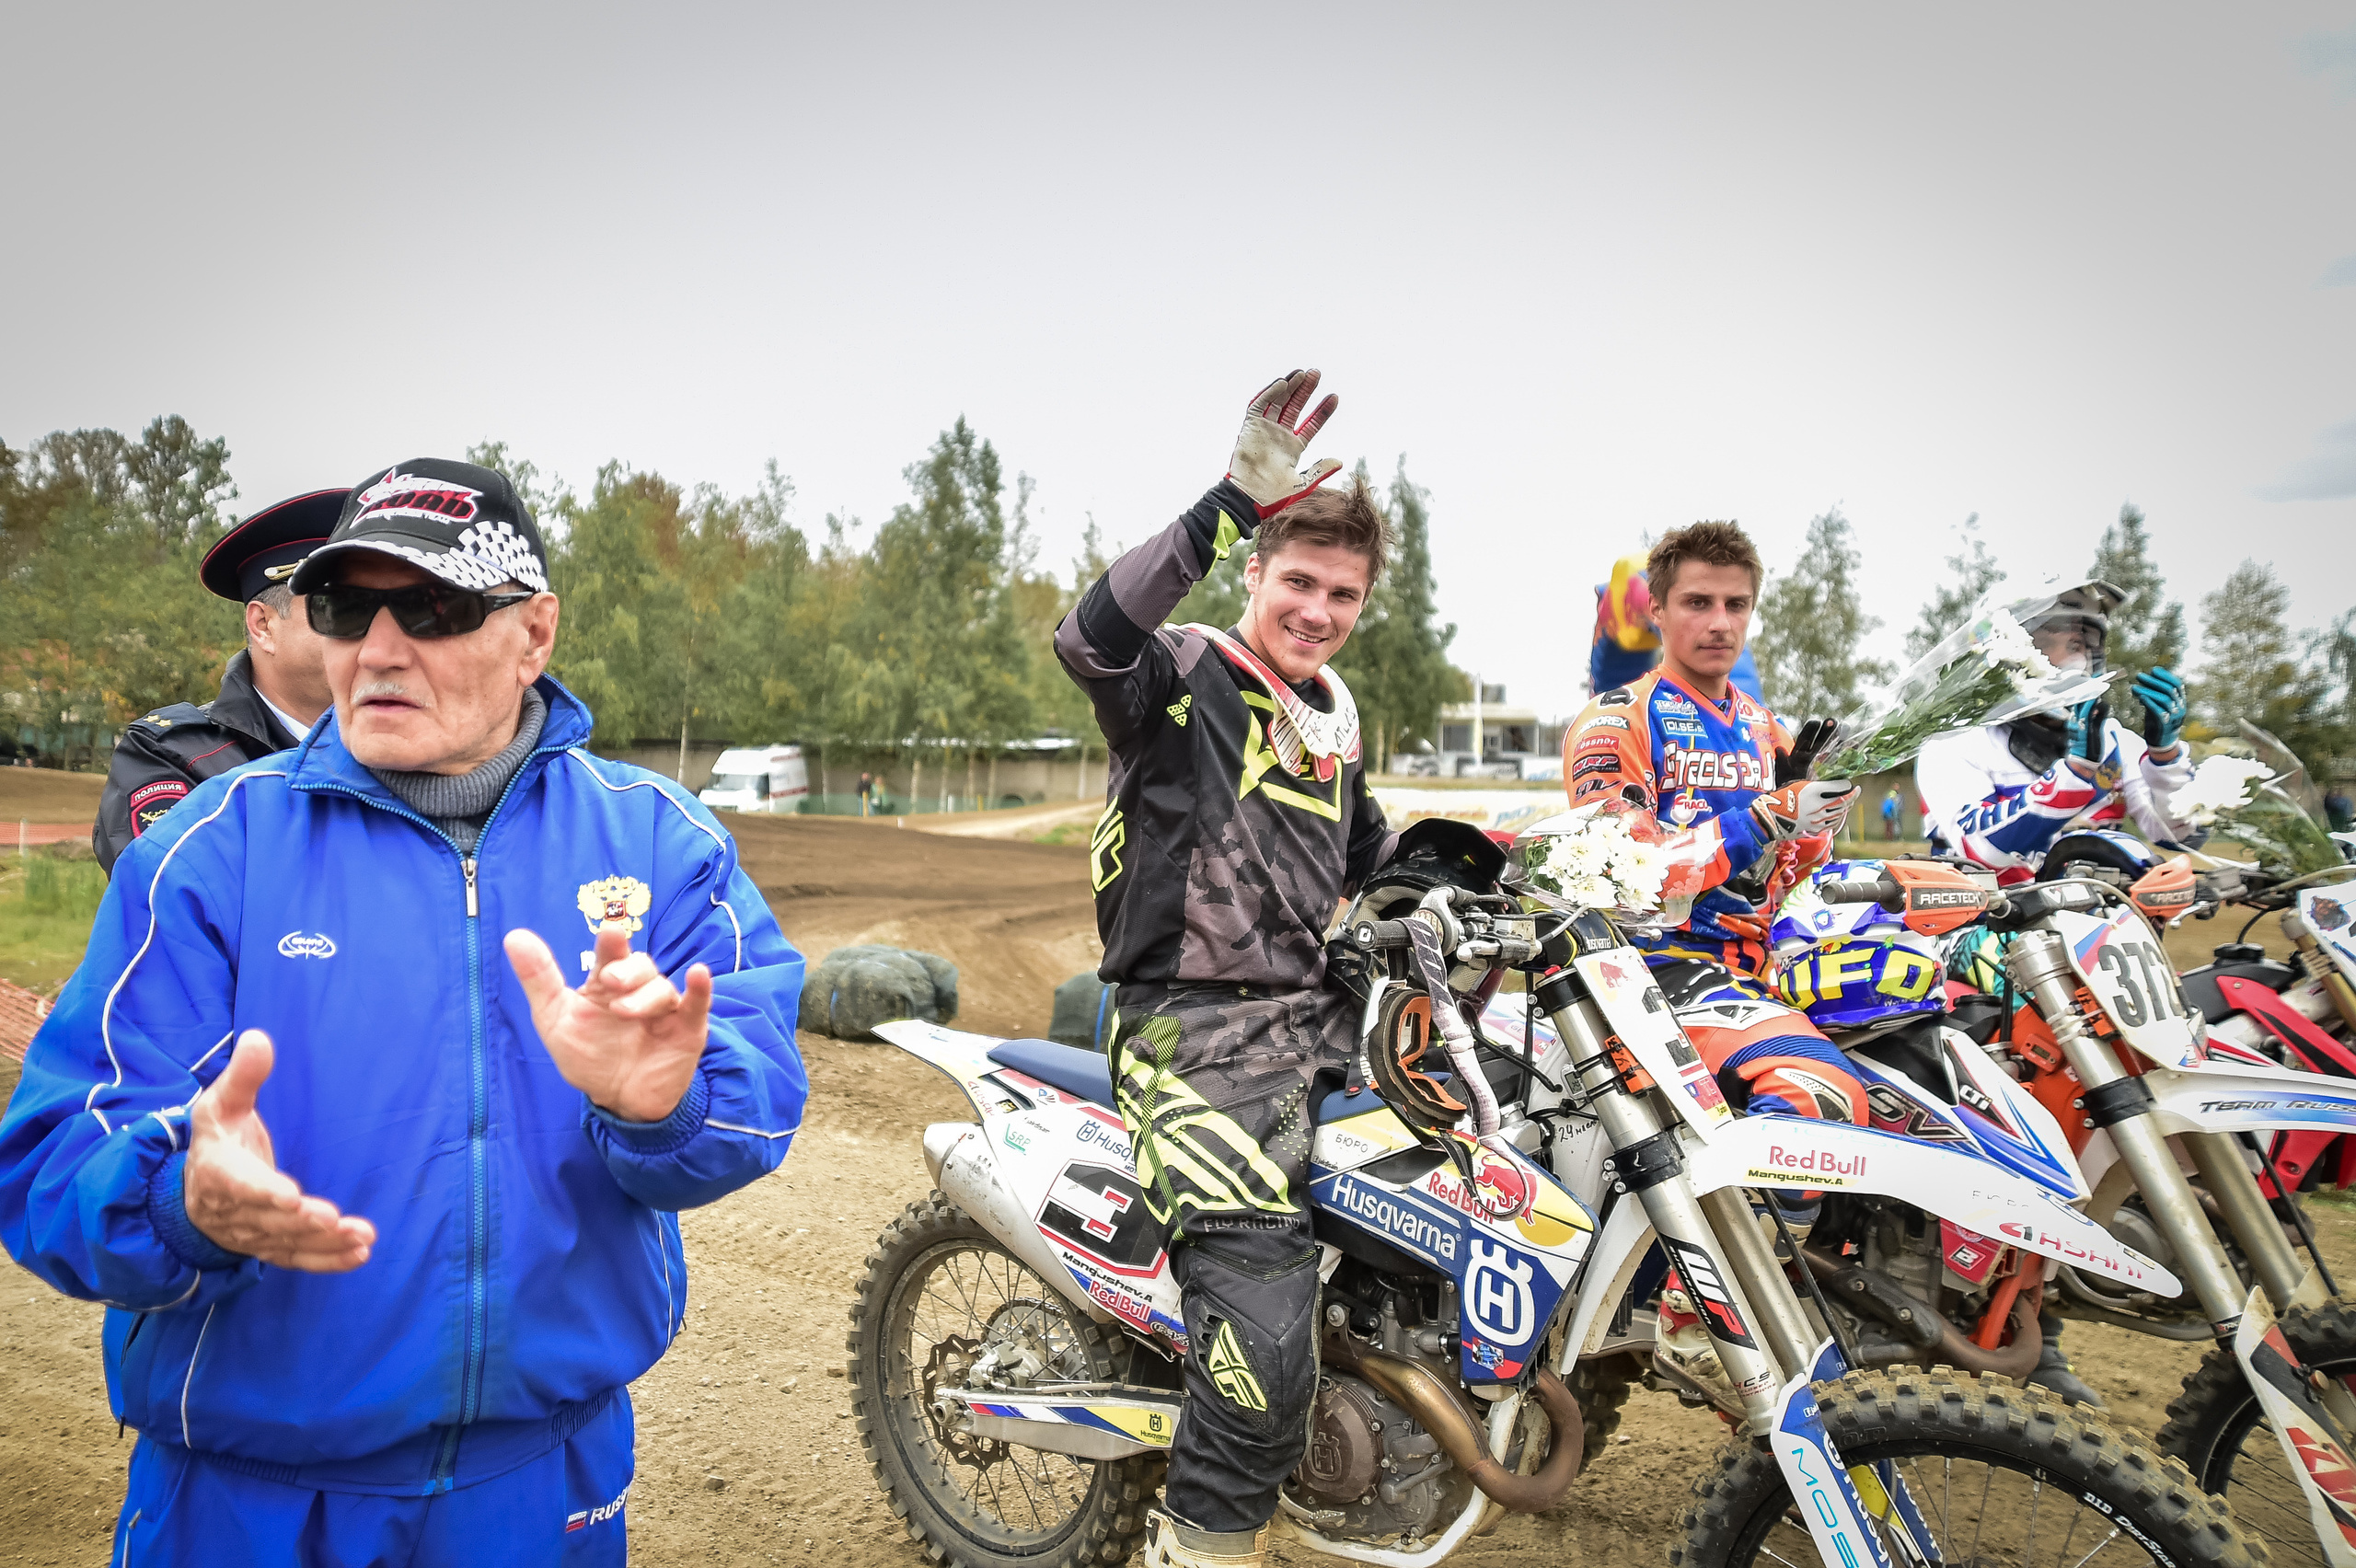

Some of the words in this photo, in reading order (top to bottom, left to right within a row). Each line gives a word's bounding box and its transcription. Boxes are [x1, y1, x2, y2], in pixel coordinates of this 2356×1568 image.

[134, 783, 182, 801] ПОЛИЦИЯ
[1920, 892, 1980, 905] RACETECH
[1779, 946, 1935, 1011] UFO
[2200, 1101, 2277, 1113] TEAM
[1335, 1133, 1369, 1153] БЮРО
[1770, 1146, 1816, 1170] Red
[1819, 1152, 1866, 1176] Bull
[1427, 1171, 1461, 1206] Red
[1748, 1169, 1843, 1186] Mangushev.A
[1331, 1172, 1459, 1262] Husqvarna
[1062, 1251, 1154, 1303] Mangushev.A
[1089, 1280, 1121, 1310] Red
[1119, 1297, 1151, 1322] Bull
